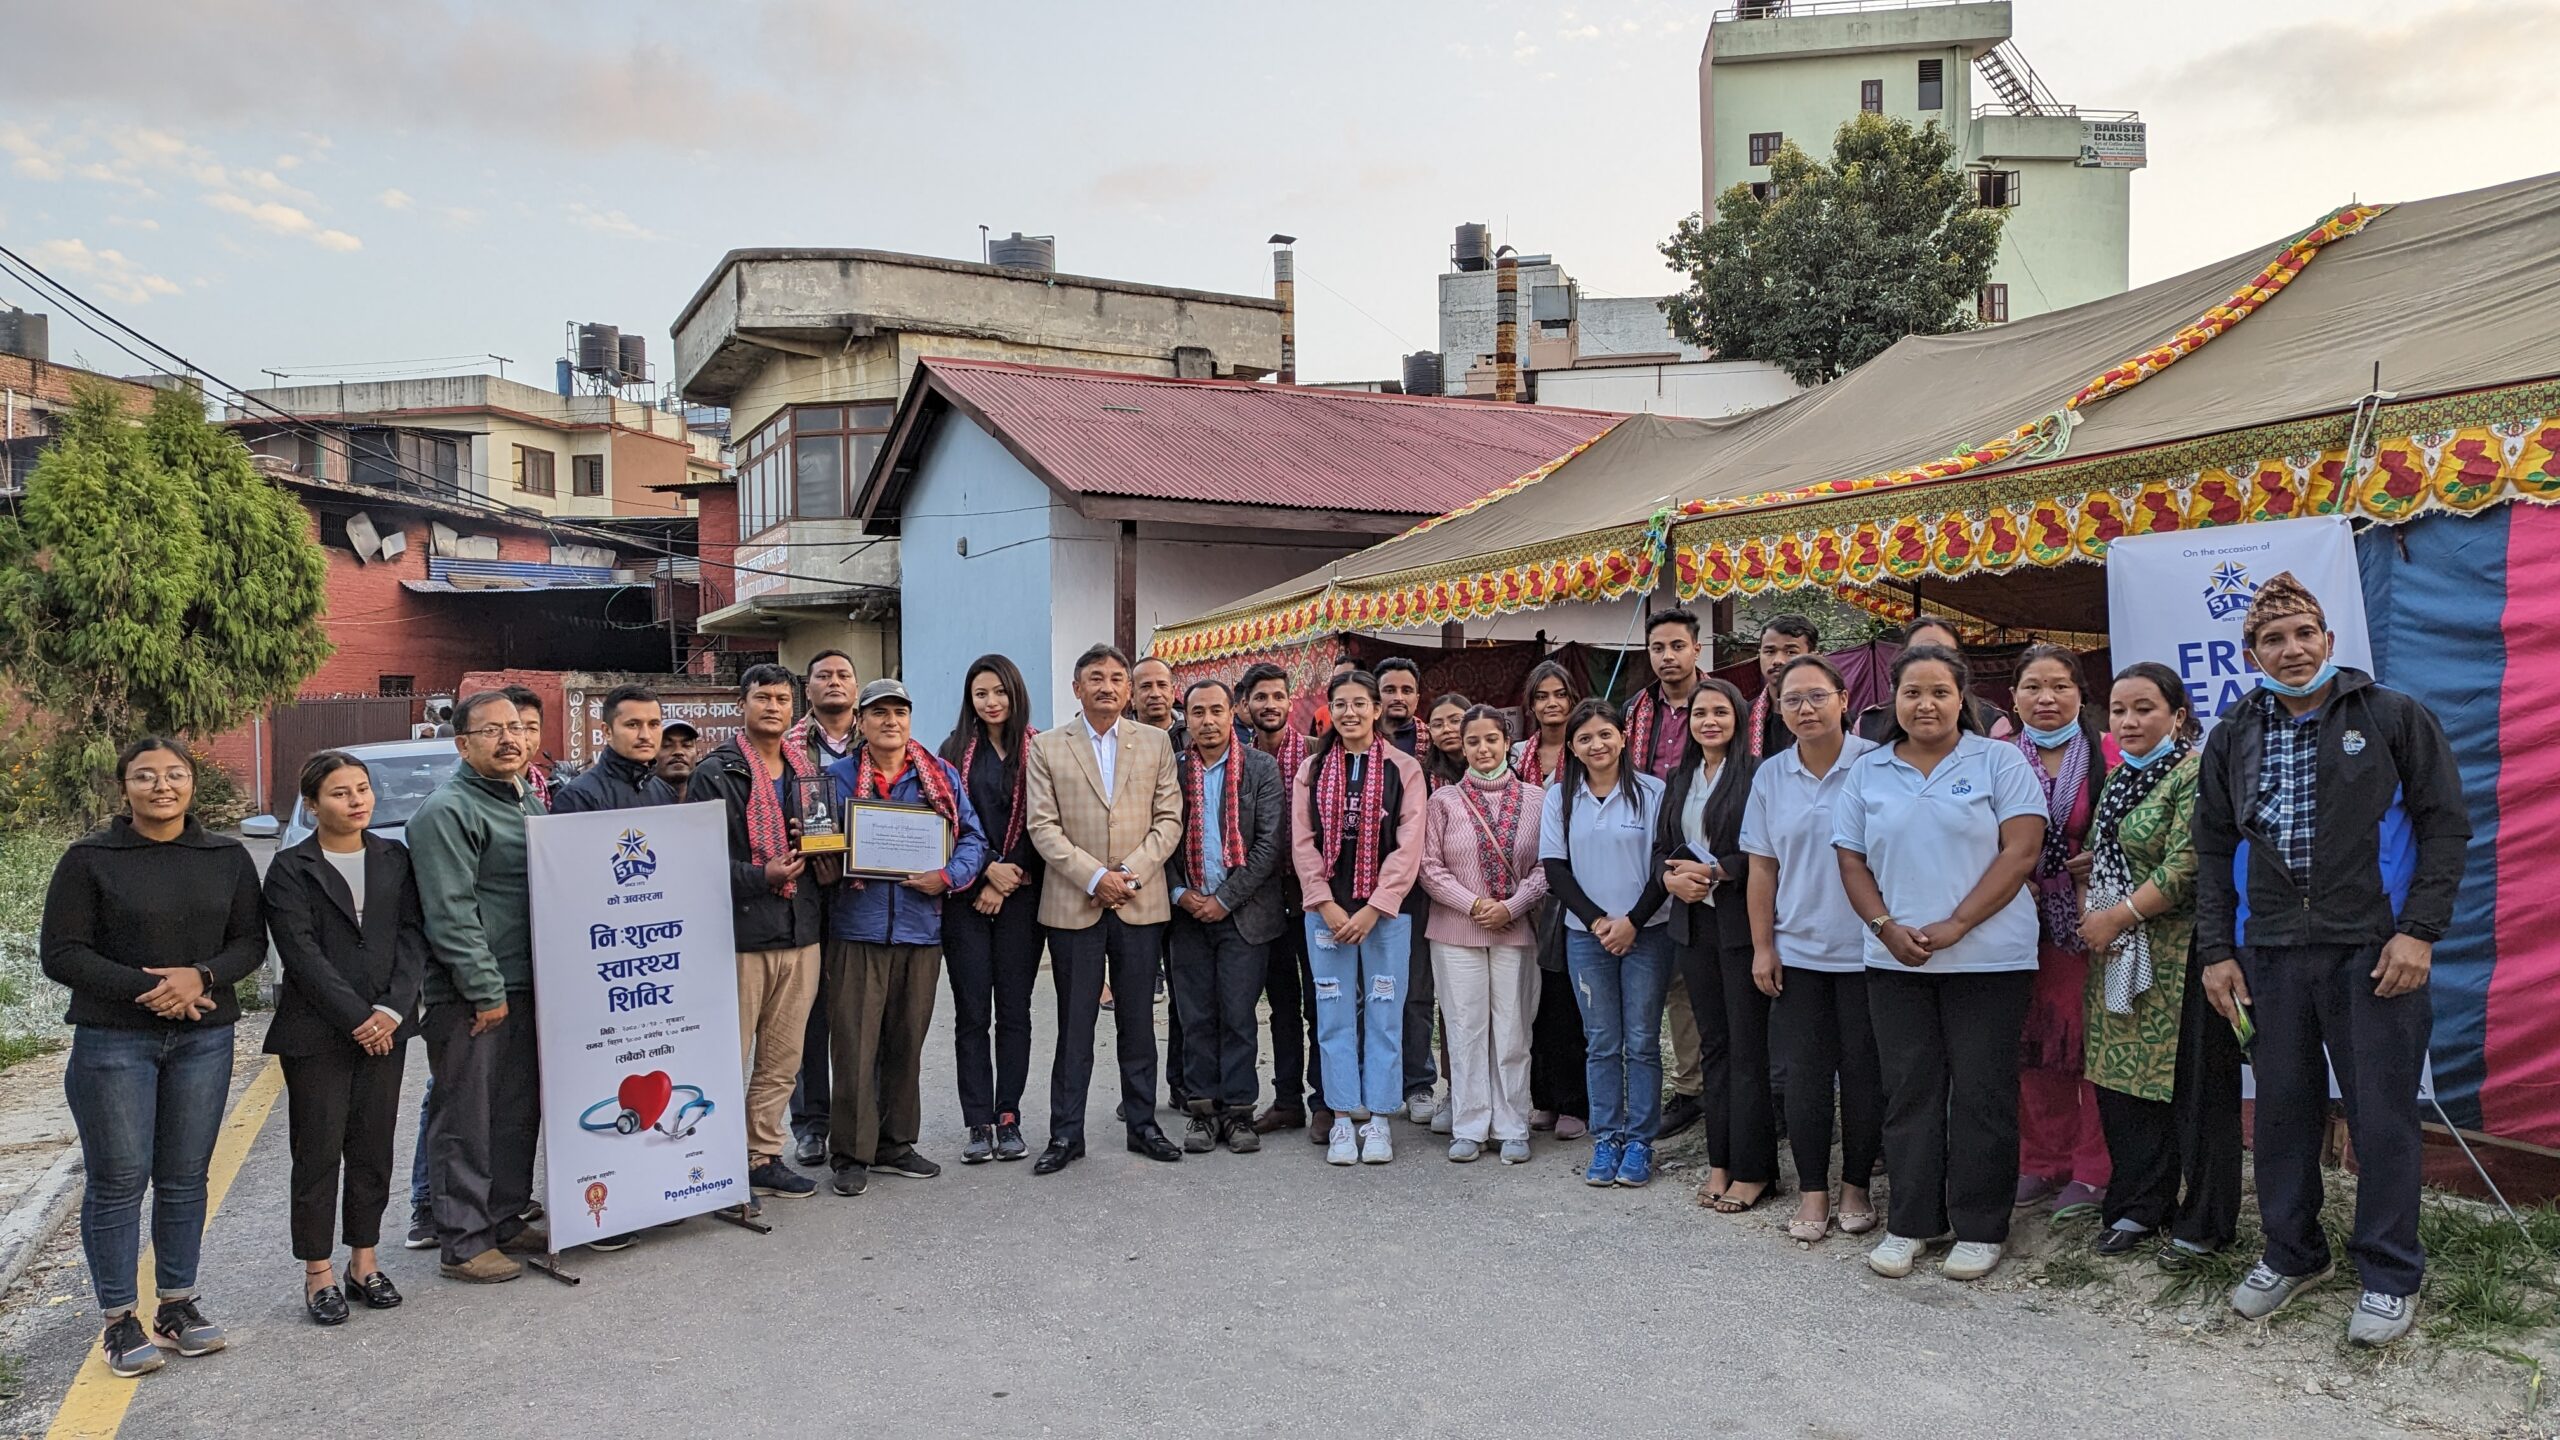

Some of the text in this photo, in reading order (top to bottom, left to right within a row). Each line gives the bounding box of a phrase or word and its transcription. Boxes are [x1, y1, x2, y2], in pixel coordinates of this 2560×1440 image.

[2094, 124, 2144, 133] BARISTA
[2094, 133, 2144, 142] CLASSES
[2182, 541, 2270, 558] On the occasion of
[2210, 594, 2234, 612] 51
[616, 861, 635, 878] 51
[607, 891, 664, 906] को अवसरमा
[596, 951, 681, 982] स्वास्थ्य
[608, 981, 674, 1013] शिविर
[615, 1048, 646, 1065] (सबैको
[664, 1177, 734, 1201] Panchakanya
